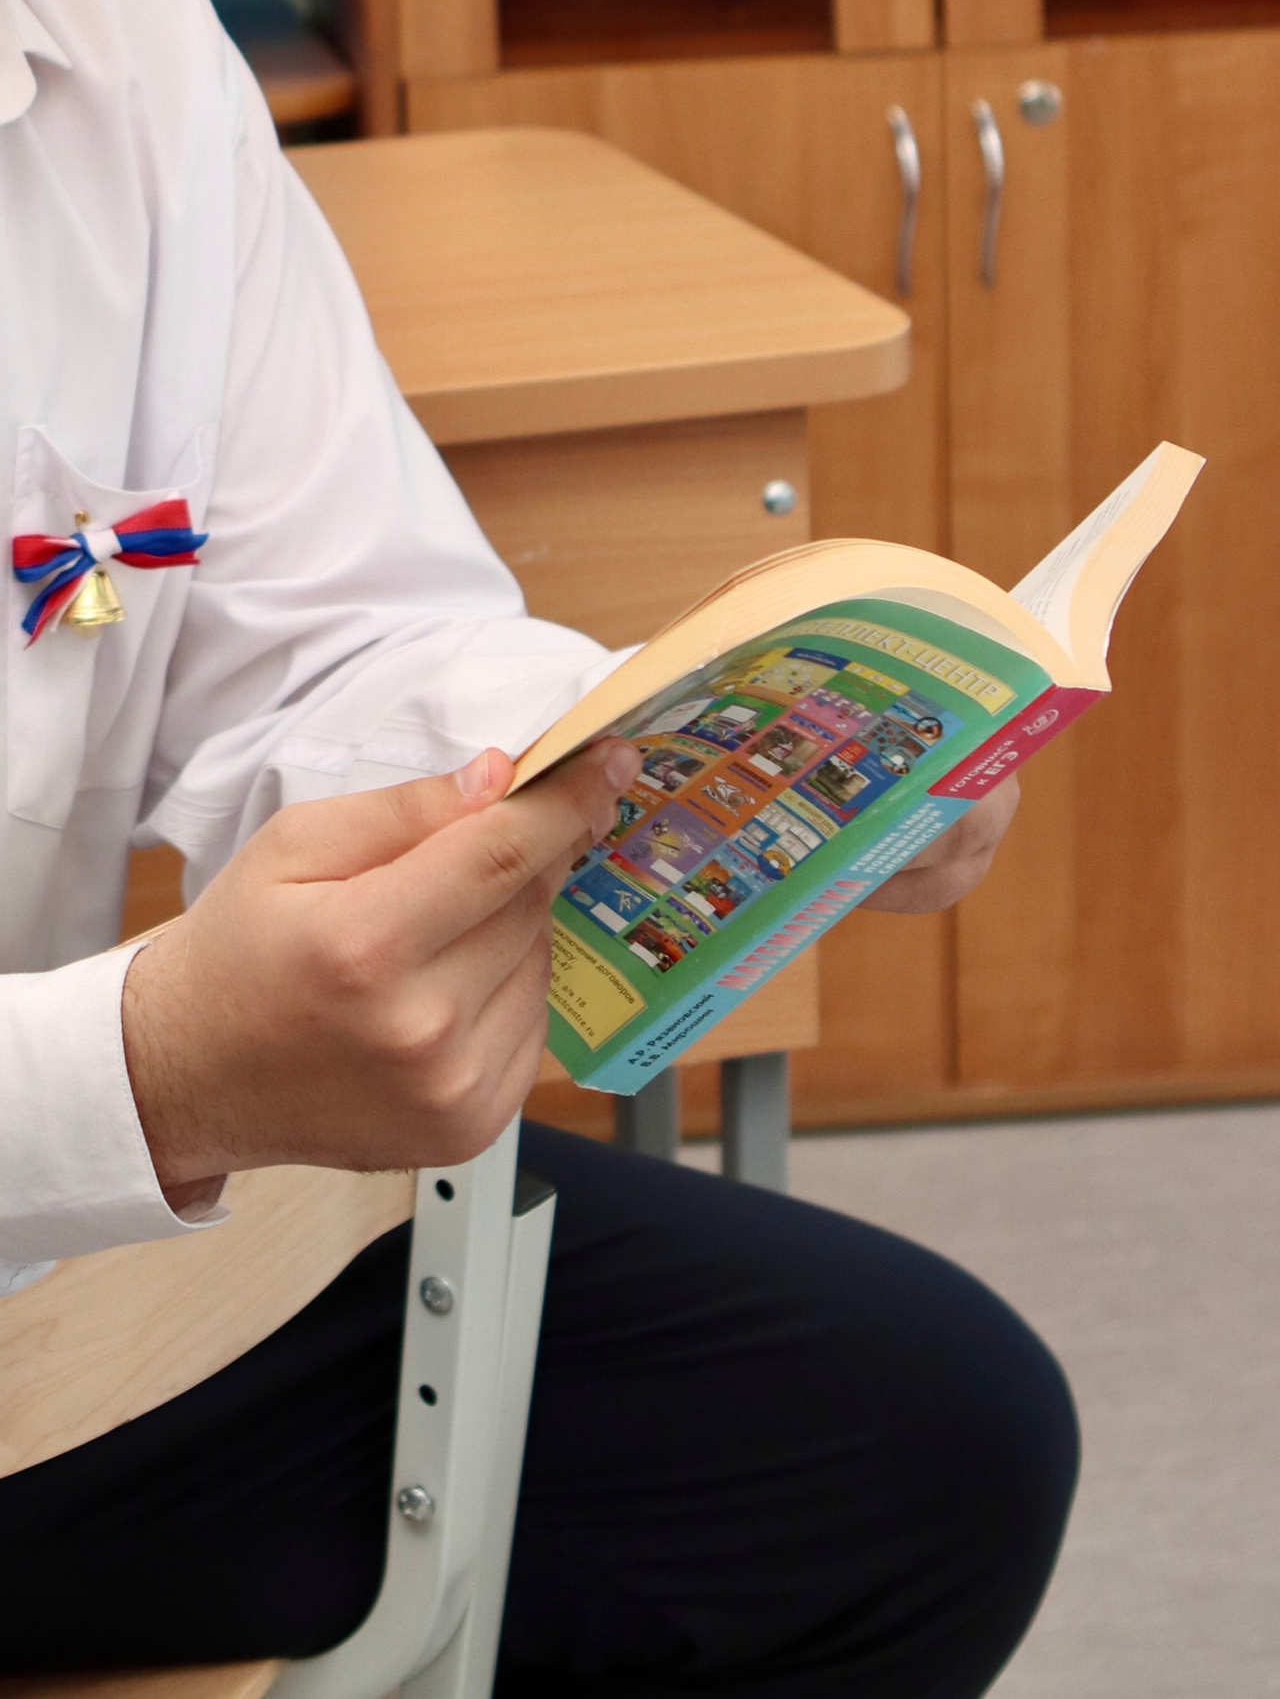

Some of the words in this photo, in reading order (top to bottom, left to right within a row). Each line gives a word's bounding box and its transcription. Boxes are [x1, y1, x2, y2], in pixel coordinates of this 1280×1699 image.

[949, 740, 1014, 792] ГОТОВИМСЯ
[984, 751, 1019, 775] ЕГЭ
[849, 832, 900, 872] РЕШЕНИЕ
[898, 803, 936, 829] ЗАДАЧ
[863, 810, 943, 873] ПОВЫШЕННОЙ
[878, 822, 945, 874] СЛОЖНОСТИ
[716, 879, 872, 991] МАТЕМАТИКА
[576, 997, 587, 1008] 18
[596, 964, 635, 1004] договоров
[646, 994, 714, 1046] Рязановский
